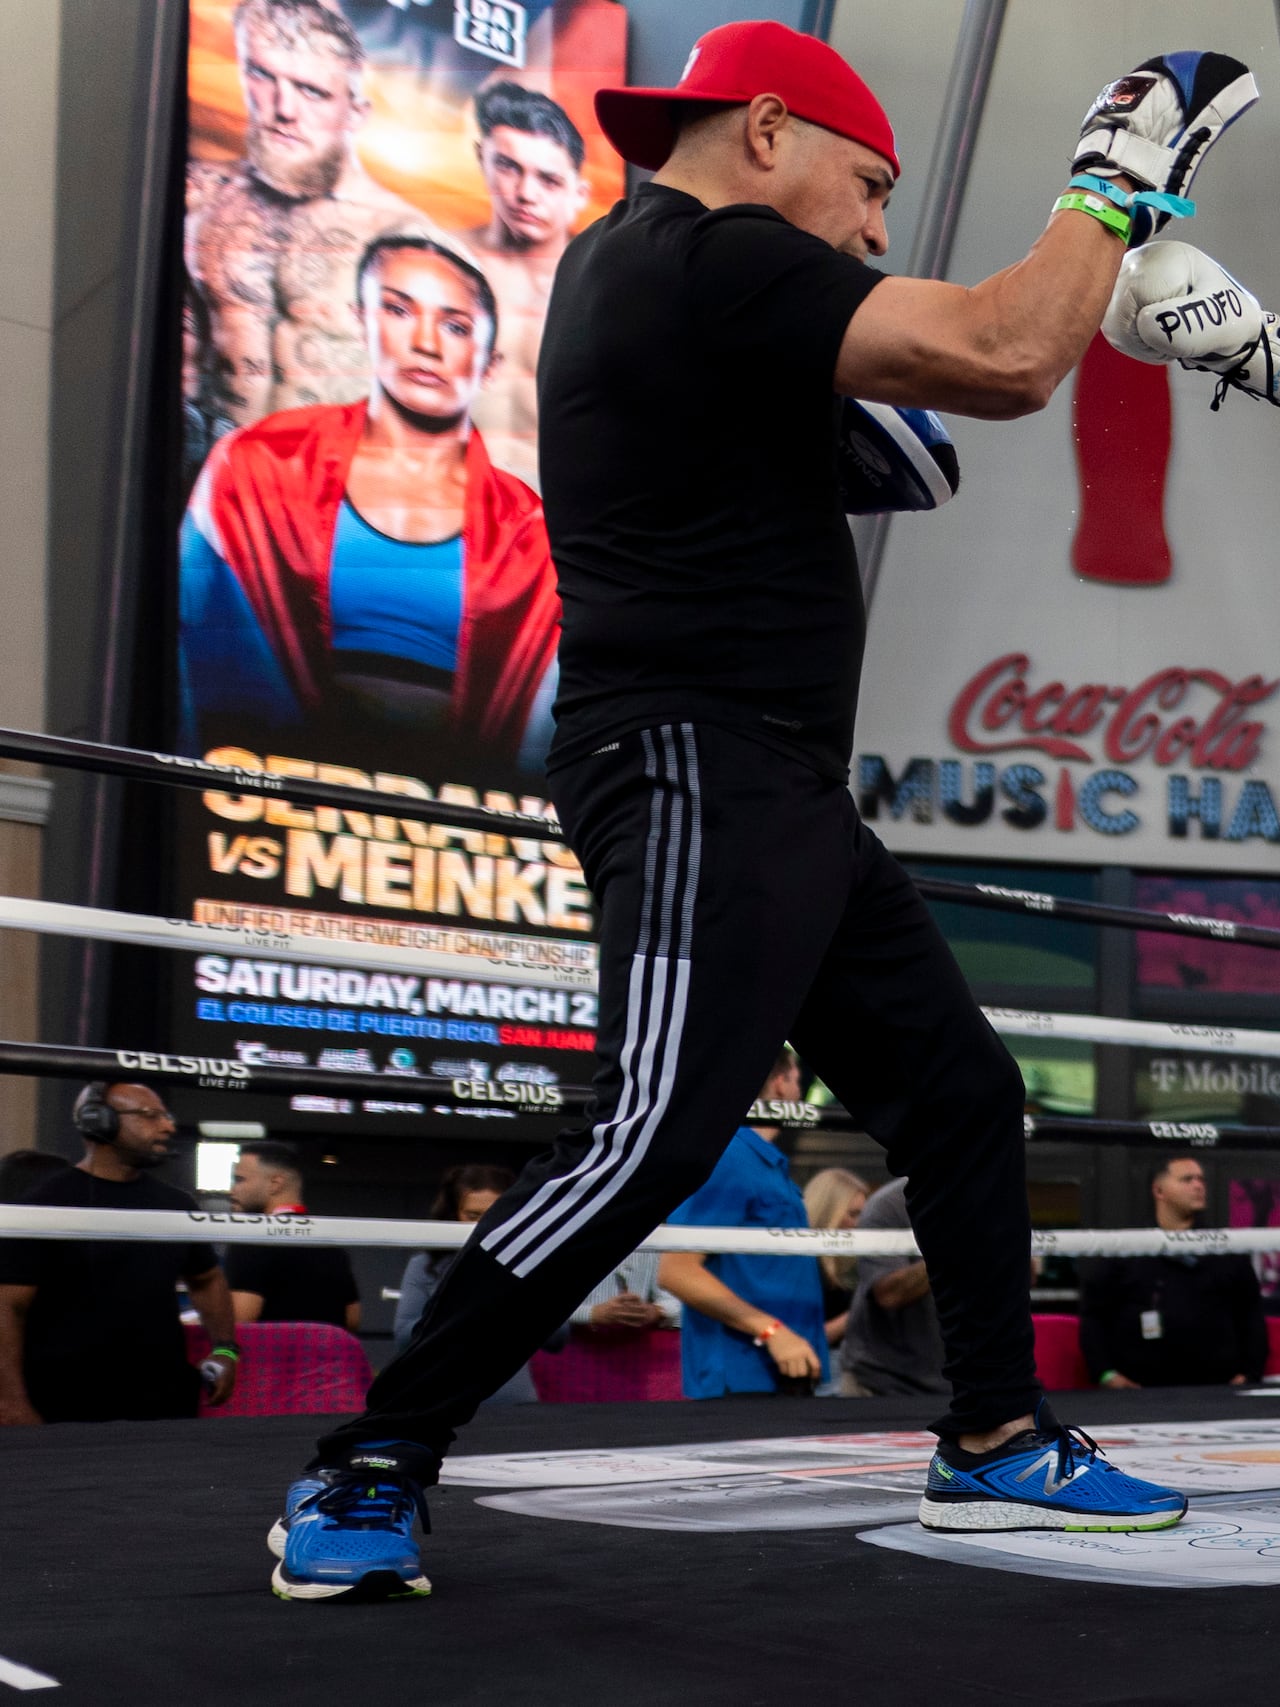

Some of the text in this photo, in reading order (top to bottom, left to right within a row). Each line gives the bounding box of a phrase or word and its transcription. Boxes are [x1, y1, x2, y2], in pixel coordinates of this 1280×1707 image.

[1155, 289, 1242, 344] PITUFO
[949, 652, 1280, 771] Coca-Cola
[858, 755, 1139, 835] MUSIC
[285, 828, 594, 932] MEINKE
[245, 937, 291, 950] LIVE FIT
[290, 914, 449, 952] FEATHERWEIGHT
[454, 933, 592, 967] CHAMPIONSHIP
[195, 954, 424, 1016] SATURDAY,
[425, 977, 569, 1025] MARCH
[197, 998, 226, 1022] EL
[227, 1002, 324, 1029] COLISEO
[326, 1009, 357, 1033] DE
[359, 1012, 442, 1039] PUERTO
[500, 1024, 542, 1047] SAN
[544, 1028, 597, 1052] JUAN
[116, 1050, 252, 1079] CELSIUS
[199, 1077, 248, 1091] LIVE FIT
[452, 1079, 564, 1105] CELSIUS
[1149, 1121, 1219, 1139] CELSIUS
[267, 1227, 312, 1237] LIVE FIT
